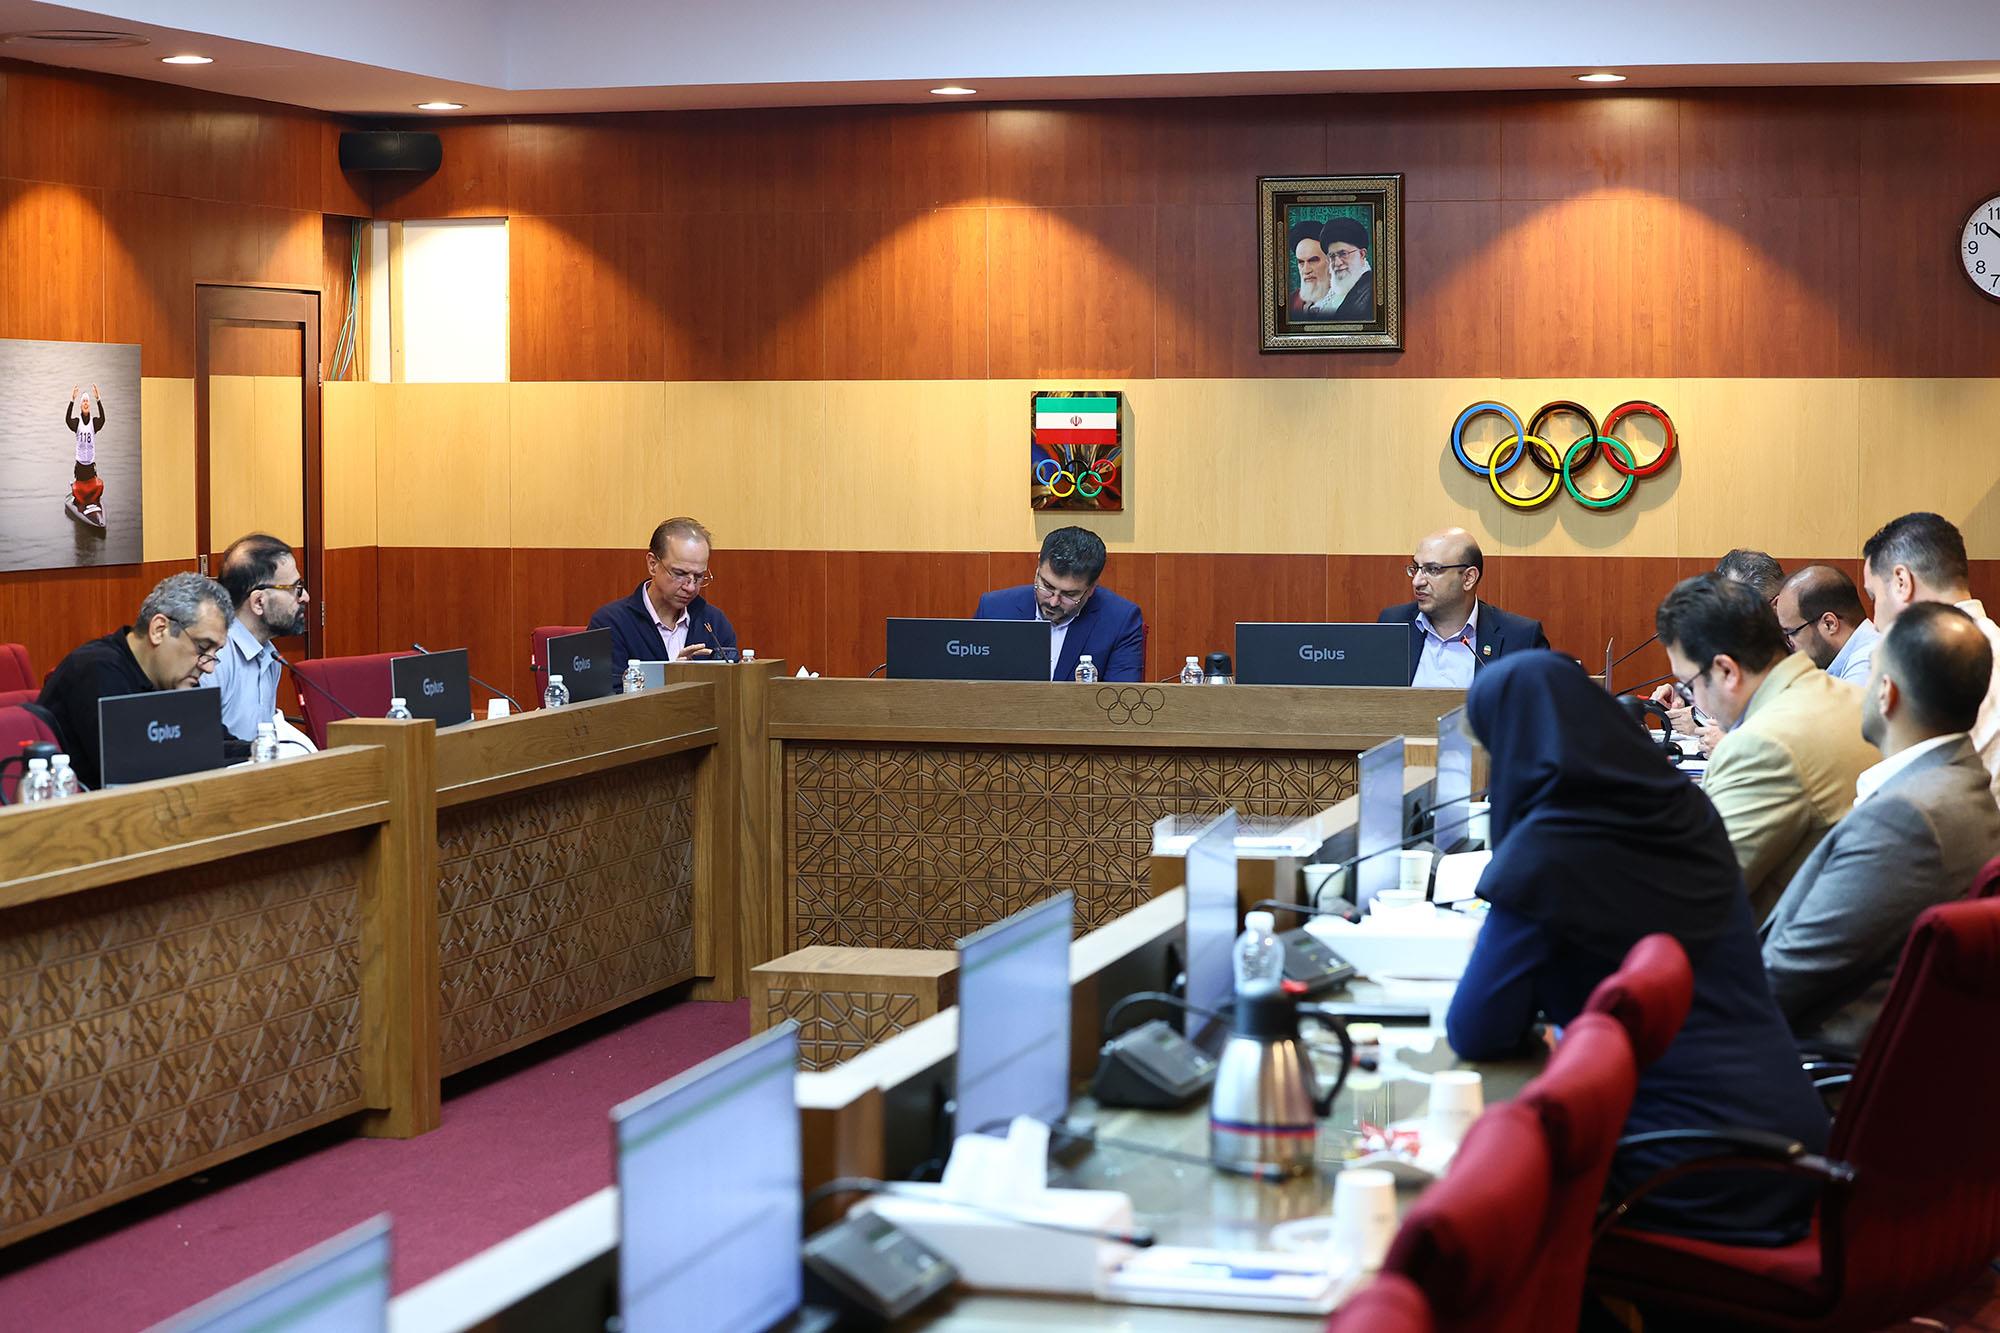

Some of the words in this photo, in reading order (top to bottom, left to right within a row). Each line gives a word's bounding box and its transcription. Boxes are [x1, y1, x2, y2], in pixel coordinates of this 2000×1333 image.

[1973, 222, 1989, 236] 10
[1968, 241, 1978, 254] 9
[1975, 260, 1986, 274] 8
[1990, 274, 2000, 288] 7
[80, 432, 91, 443] 118
[946, 640, 990, 657] Gplus
[1299, 644, 1345, 662] Gplus
[573, 655, 591, 672] Gplus
[422, 678, 445, 697] Gplus
[147, 720, 182, 743] Gplus
